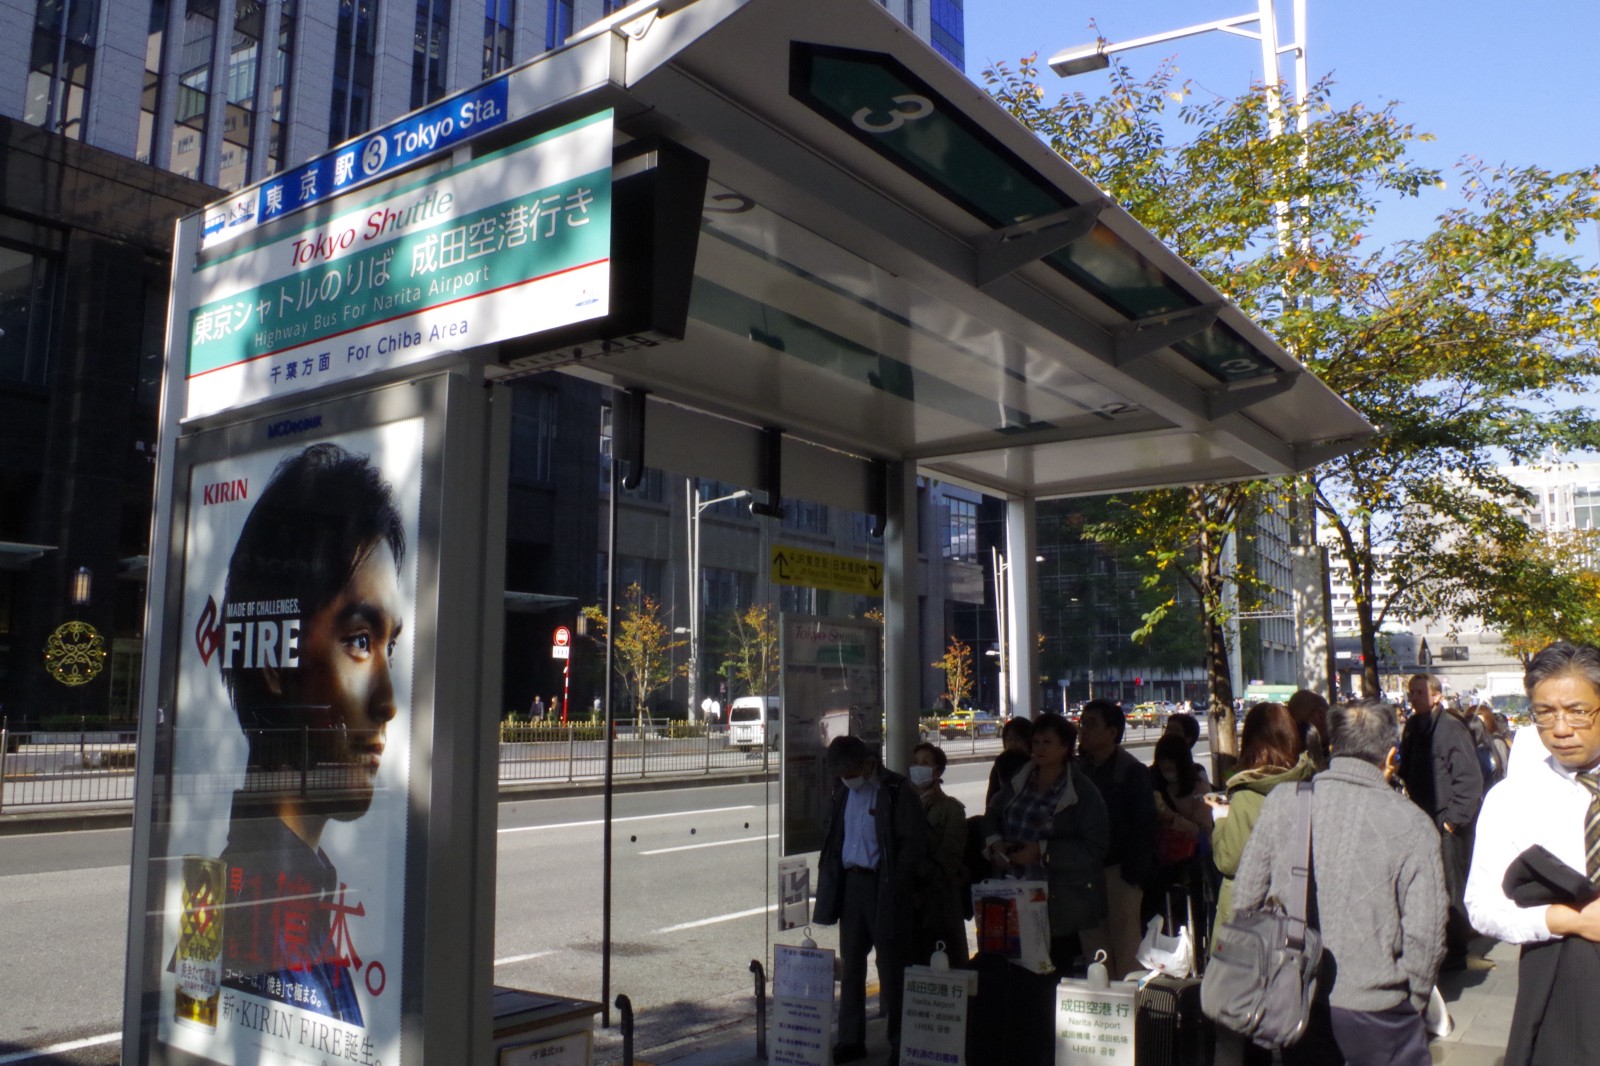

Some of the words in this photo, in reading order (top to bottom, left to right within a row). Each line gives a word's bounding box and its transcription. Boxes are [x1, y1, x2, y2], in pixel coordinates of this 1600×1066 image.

[266, 151, 355, 215] 東京駅
[394, 116, 454, 157] Tokyo
[459, 98, 501, 130] Sta.
[292, 228, 356, 266] Tokyo
[364, 190, 453, 241] Shuttle
[194, 247, 395, 346] 東京シャトルのりば
[410, 188, 594, 278] 成田空港行き
[255, 321, 308, 348] Highway
[314, 312, 337, 330] Bus
[343, 303, 367, 321] For
[373, 286, 421, 313] Narita
[428, 265, 490, 297] Airport
[270, 352, 331, 384] 千葉方面
[347, 342, 371, 363] For
[378, 330, 421, 355] Chiba
[429, 319, 468, 342] Area
[203, 478, 249, 506] KIRIN
[226, 602, 247, 617] MADE
[247, 601, 255, 616] OF
[256, 598, 301, 615] CHALLENGES.
[223, 619, 301, 669] FIRE
[906, 980, 948, 997] 成田空港
[952, 984, 963, 999] 行
[1060, 998, 1112, 1016] 成田空港
[1116, 1003, 1130, 1018] 行
[1068, 1017, 1092, 1027] Narita
[1094, 1019, 1121, 1030] Airport
